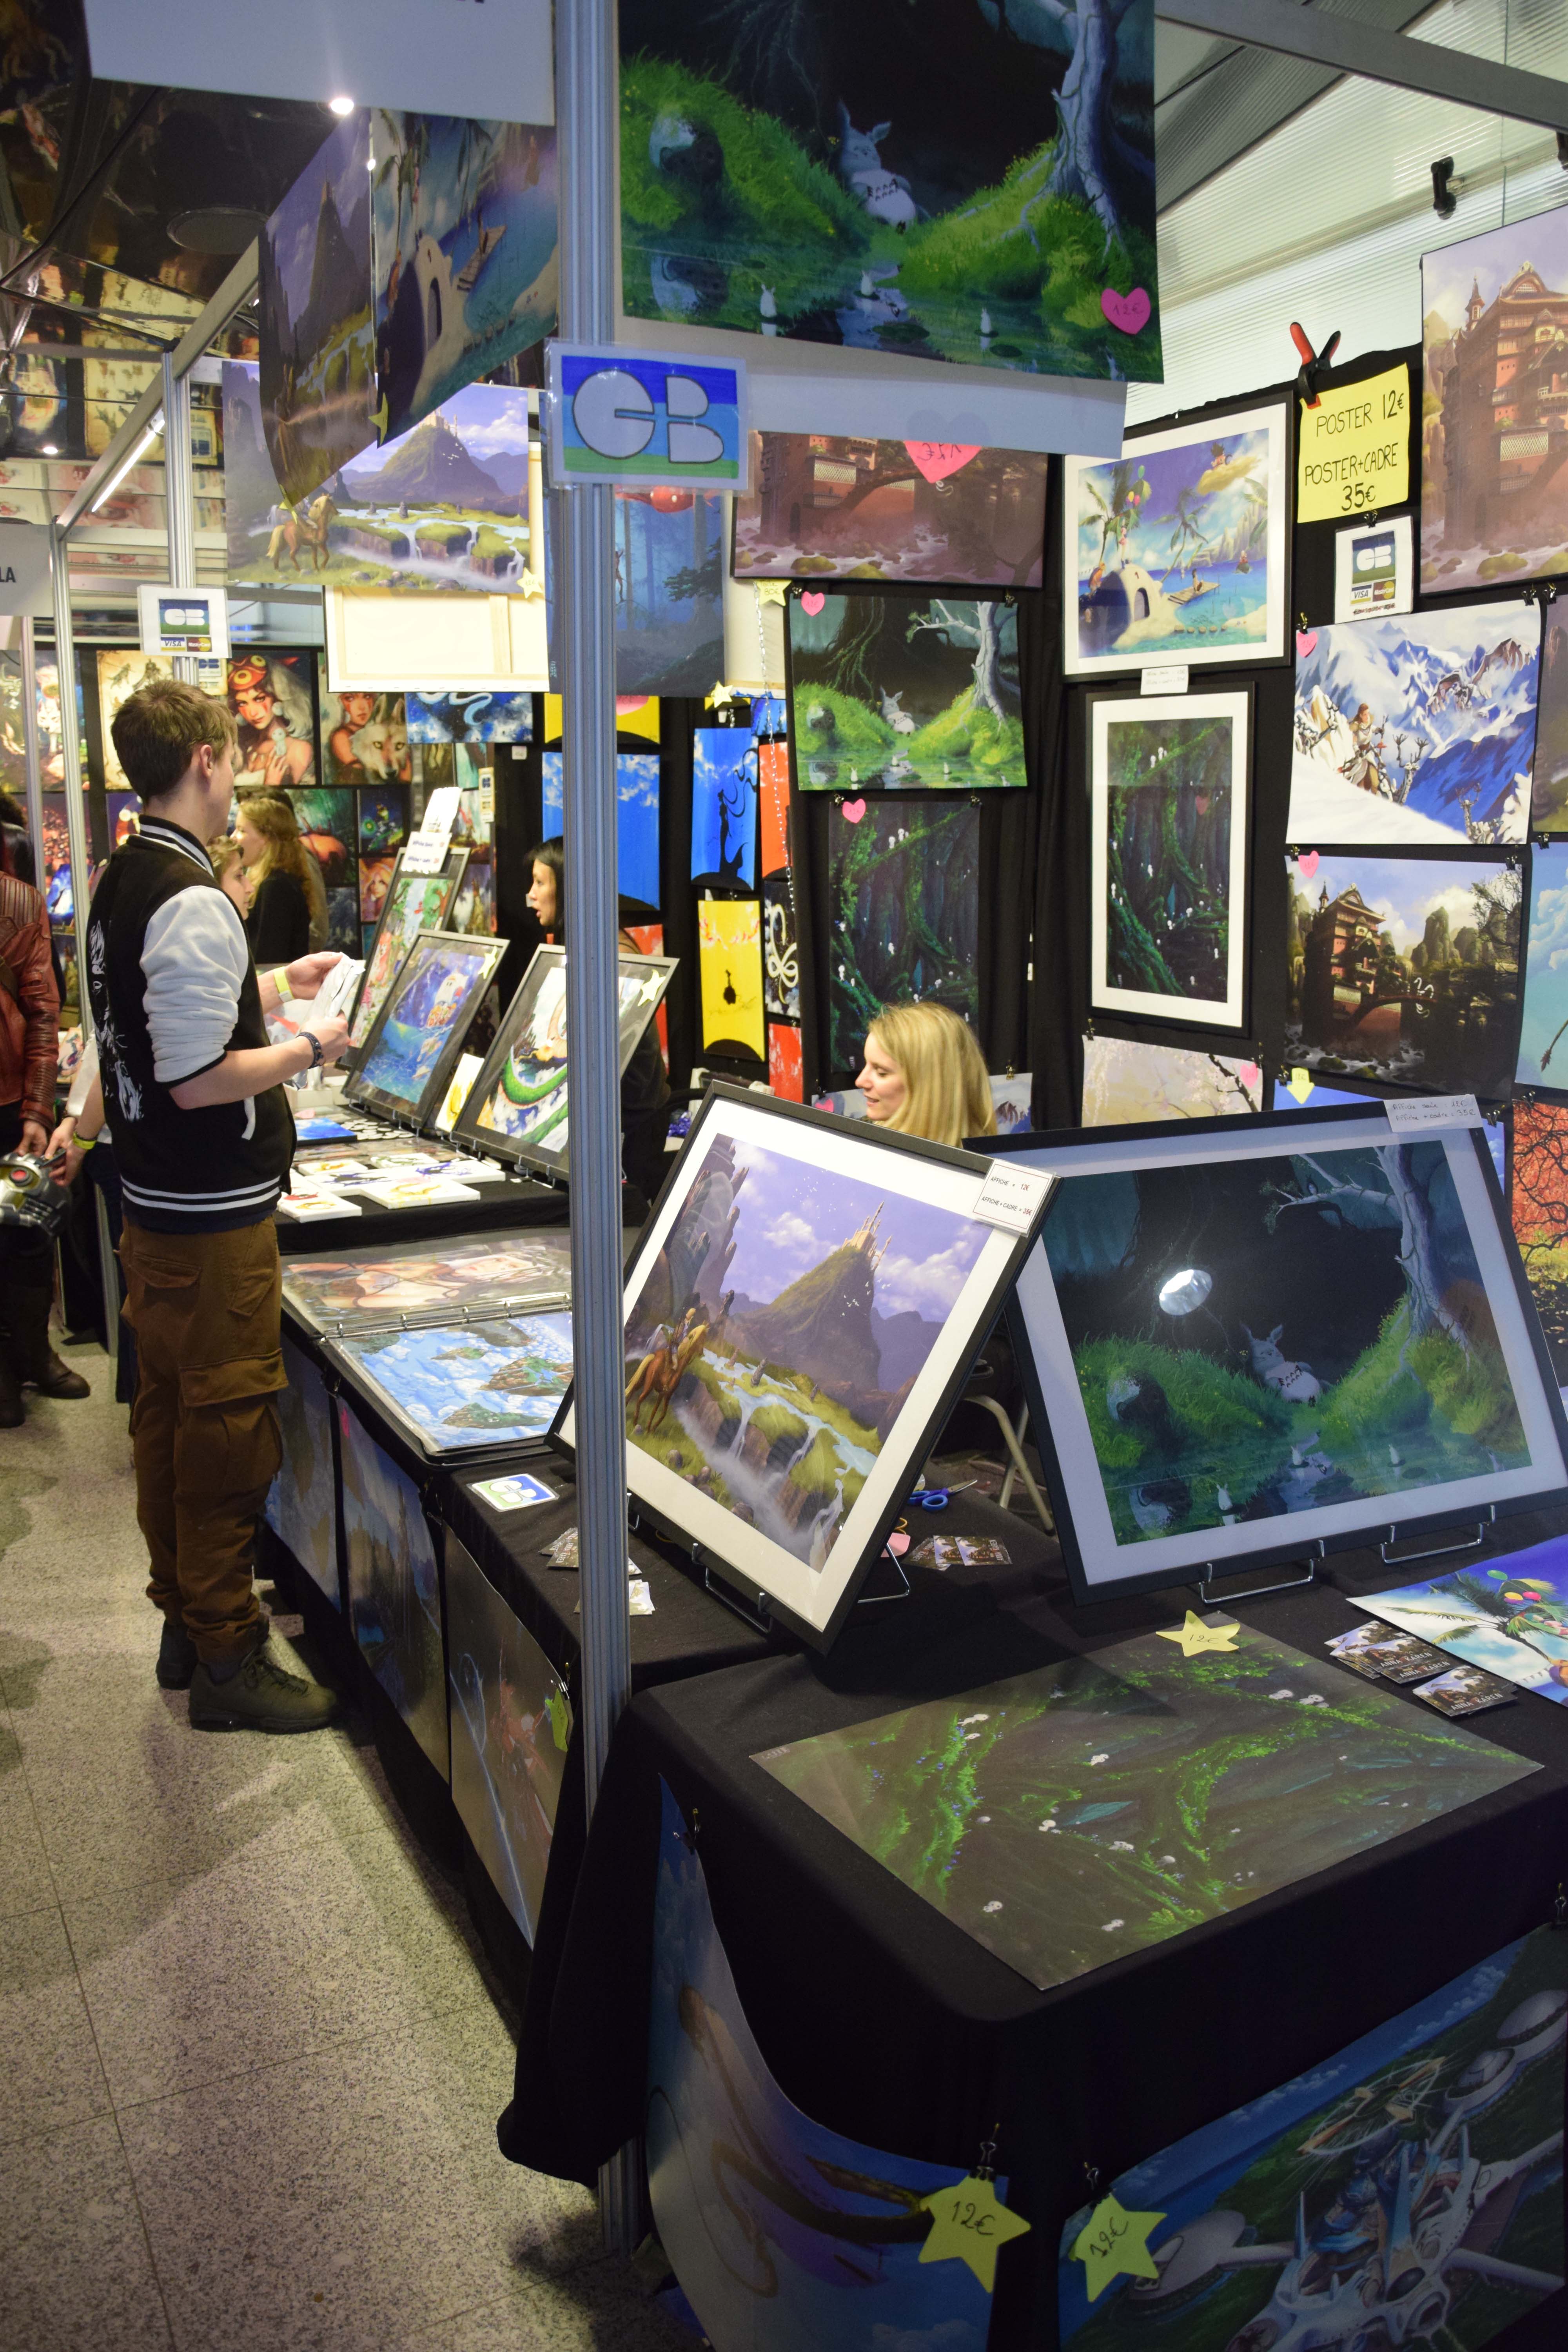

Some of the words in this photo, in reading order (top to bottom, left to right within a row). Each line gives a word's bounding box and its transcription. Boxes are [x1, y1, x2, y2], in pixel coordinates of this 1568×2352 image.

[1112, 303, 1143, 316] 12€
[573, 368, 724, 463] CB
[1316, 403, 1372, 437] POSTER
[1383, 390, 1404, 419] 12€
[1305, 443, 1398, 486] POSTER+CADRE
[1341, 482, 1376, 512] 35€
[1357, 545, 1392, 571] CB
[1354, 590, 1368, 599] VISA
[164, 609, 205, 626] CB
[1456, 1109, 1476, 1117] 35€
[990, 1176, 1009, 1186] AFFICHE
[1020, 1183, 1030, 1191] 12€
[982, 1196, 1000, 1206] AFFICHE
[1003, 1202, 1018, 1212] CADRE
[1190, 1634, 1220, 1644] 12€
[1380, 1659, 1403, 1668] ANNA
[1405, 1652, 1433, 1662] KAREN
[1399, 1669, 1422, 1678] ANNA
[1423, 1661, 1451, 1671] KAREN
[1451, 1701, 1474, 1711] ANNA
[1475, 1693, 1504, 1704] KAREN
[952, 2201, 995, 2236] 12€
